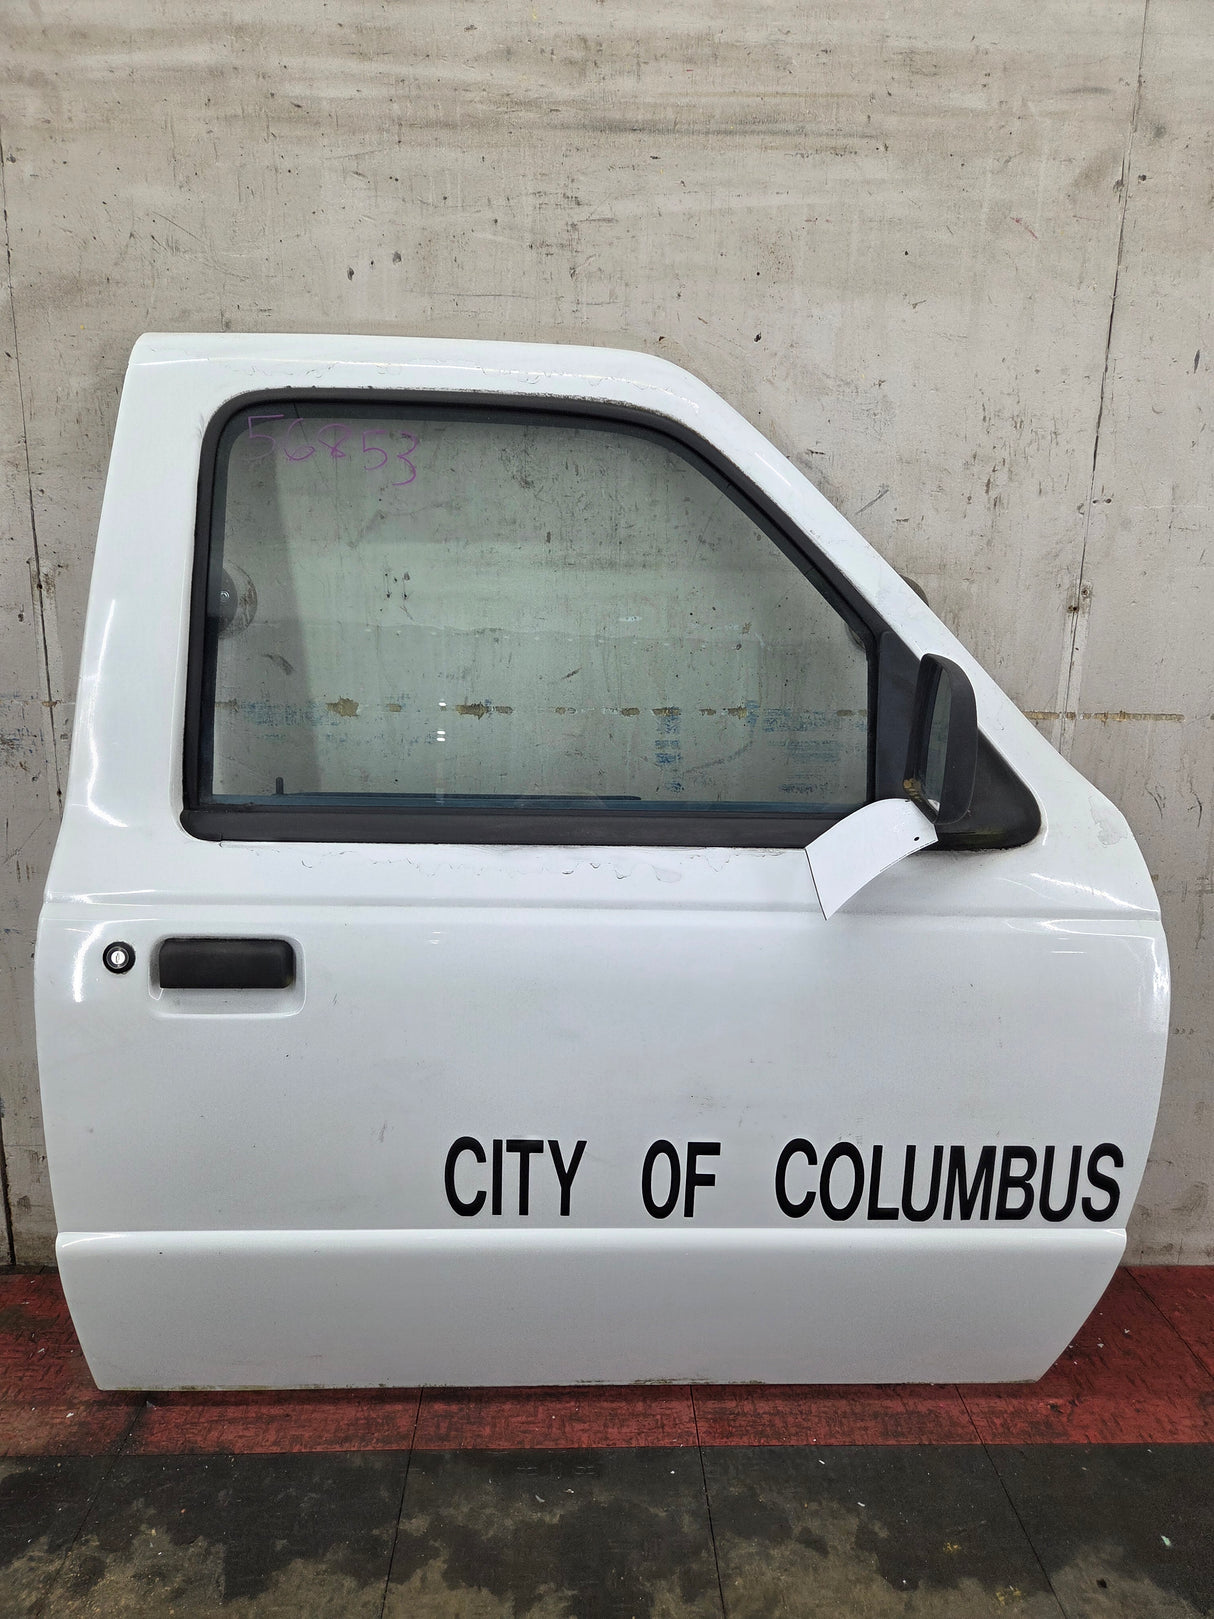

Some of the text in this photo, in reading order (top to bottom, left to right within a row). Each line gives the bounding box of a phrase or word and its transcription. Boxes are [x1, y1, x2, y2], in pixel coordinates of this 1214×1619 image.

[244, 414, 419, 486] 56853
[445, 1136, 1124, 1222] CITY OF COLUMBUS
